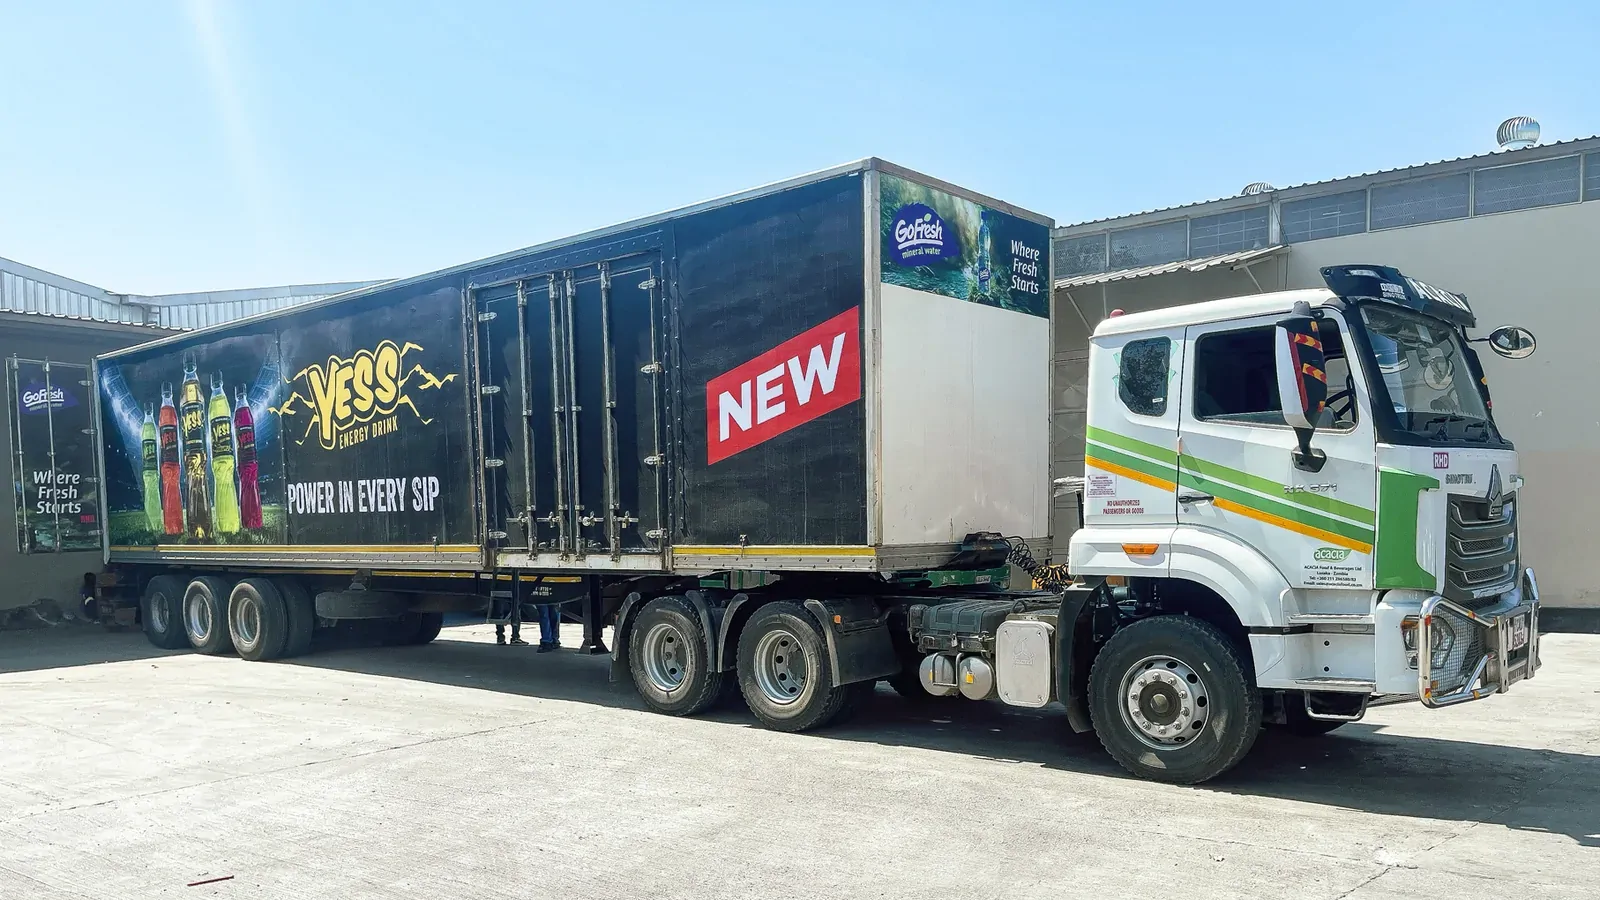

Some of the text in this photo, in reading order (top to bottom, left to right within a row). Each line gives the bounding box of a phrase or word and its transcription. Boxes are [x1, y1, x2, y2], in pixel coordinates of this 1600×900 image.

[895, 217, 943, 244] GoFresh
[902, 247, 941, 259] mineral water
[1011, 240, 1040, 261] Where
[1013, 258, 1037, 277] Fresh
[1011, 275, 1039, 295] Starts
[307, 340, 400, 449] YESS
[719, 332, 846, 443] NEW
[339, 415, 399, 450] ENERGY DRINK
[1434, 454, 1448, 468] RHD
[287, 476, 440, 514] POWER IN EVERY SIP
[1314, 550, 1344, 559] acacia
